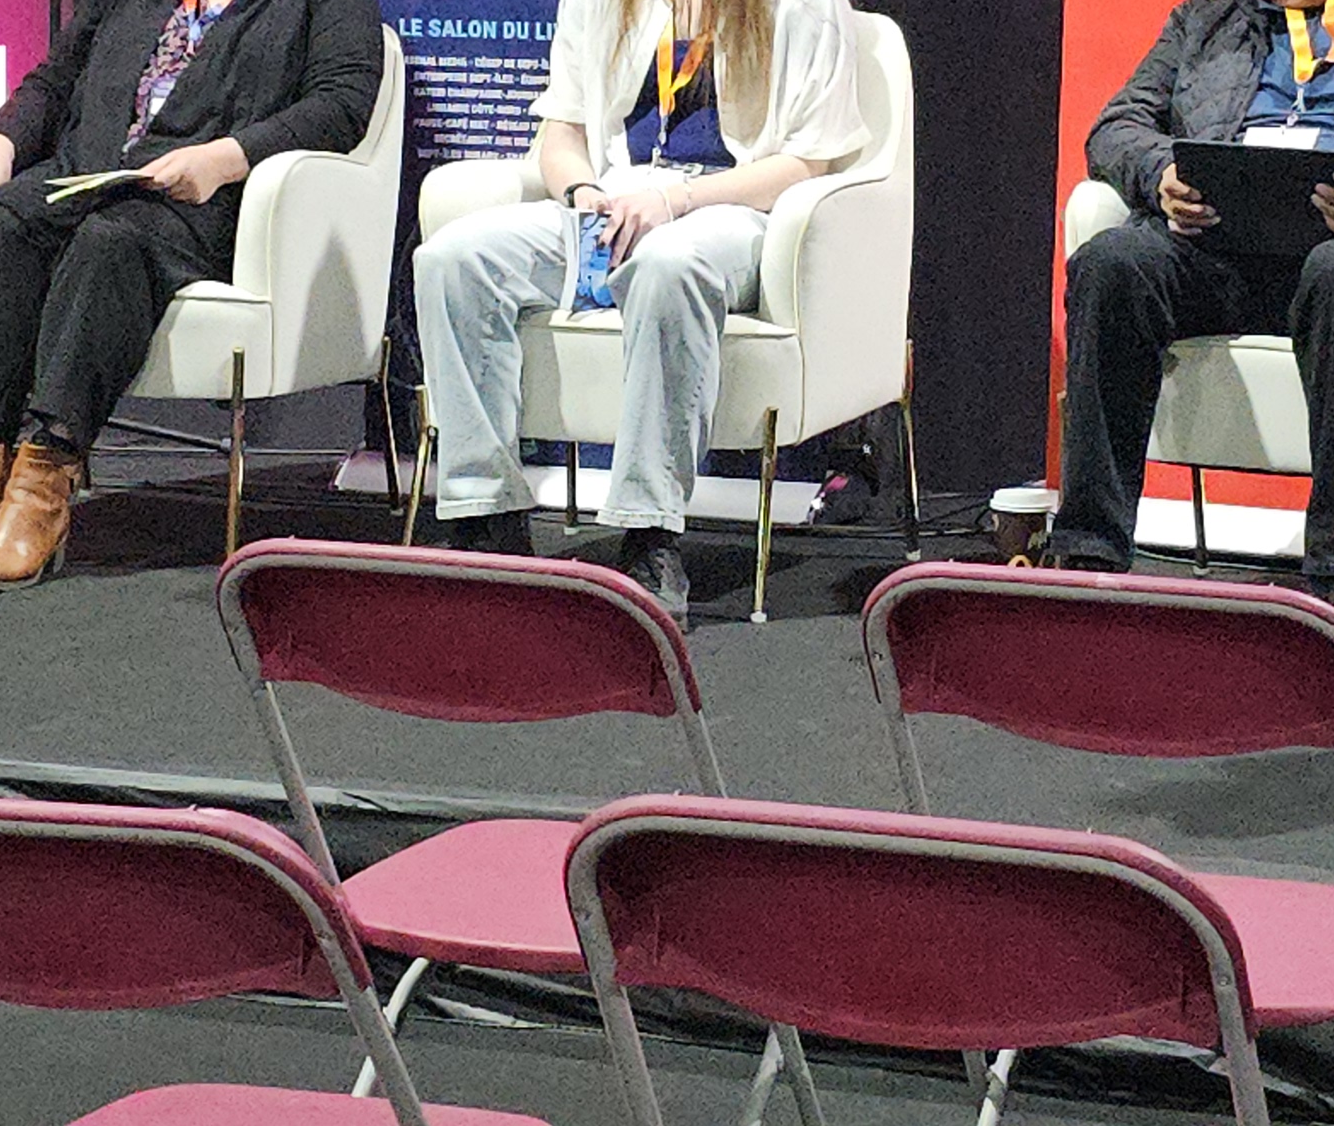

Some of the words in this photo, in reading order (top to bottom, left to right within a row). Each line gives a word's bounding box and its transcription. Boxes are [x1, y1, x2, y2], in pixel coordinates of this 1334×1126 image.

[399, 18, 423, 37] LE
[428, 19, 497, 39] SALON
[503, 21, 529, 40] DU
